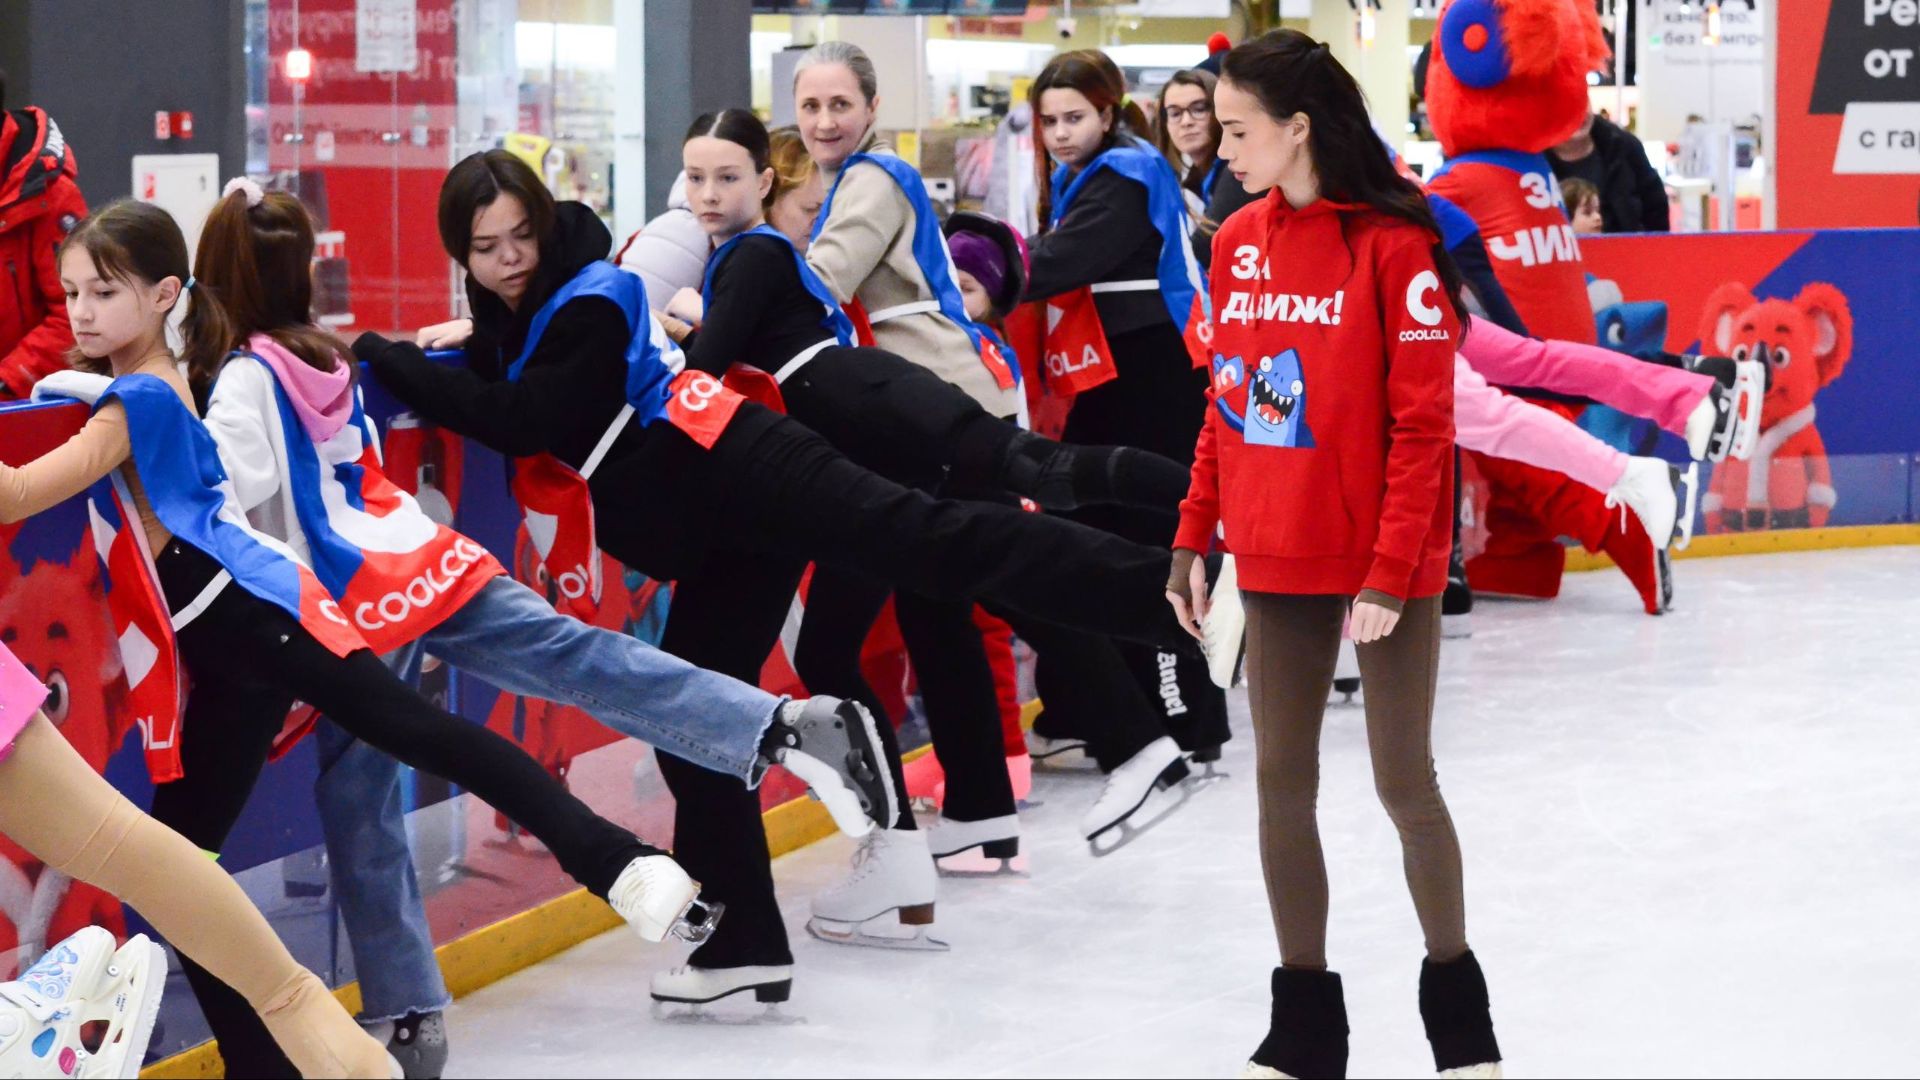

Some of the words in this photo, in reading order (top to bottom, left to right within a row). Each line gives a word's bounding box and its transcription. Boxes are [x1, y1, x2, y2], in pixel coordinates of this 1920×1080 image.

[1864, 0, 1920, 26] Ре
[1863, 48, 1914, 78] от
[1887, 130, 1920, 154] га
[1231, 245, 1271, 280] ЗА
[1220, 290, 1345, 326] ДВИЖ!
